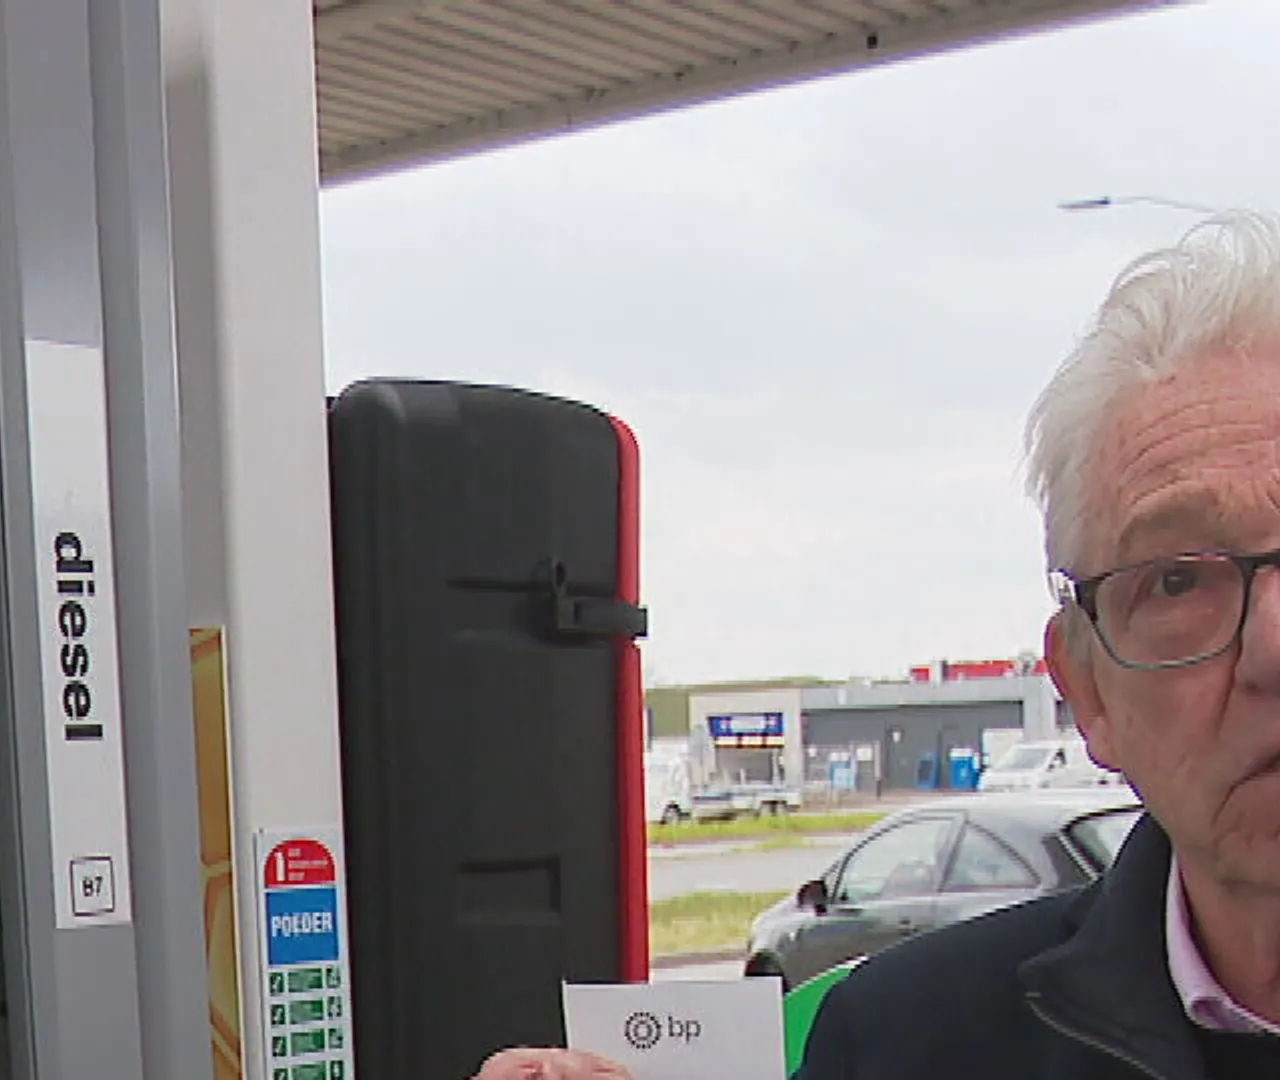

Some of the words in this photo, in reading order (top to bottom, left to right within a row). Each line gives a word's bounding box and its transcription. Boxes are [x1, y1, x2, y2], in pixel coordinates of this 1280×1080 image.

[54, 531, 104, 742] diesel
[82, 876, 103, 897] B7
[271, 911, 333, 937] POEDER
[668, 1015, 701, 1041] bp
